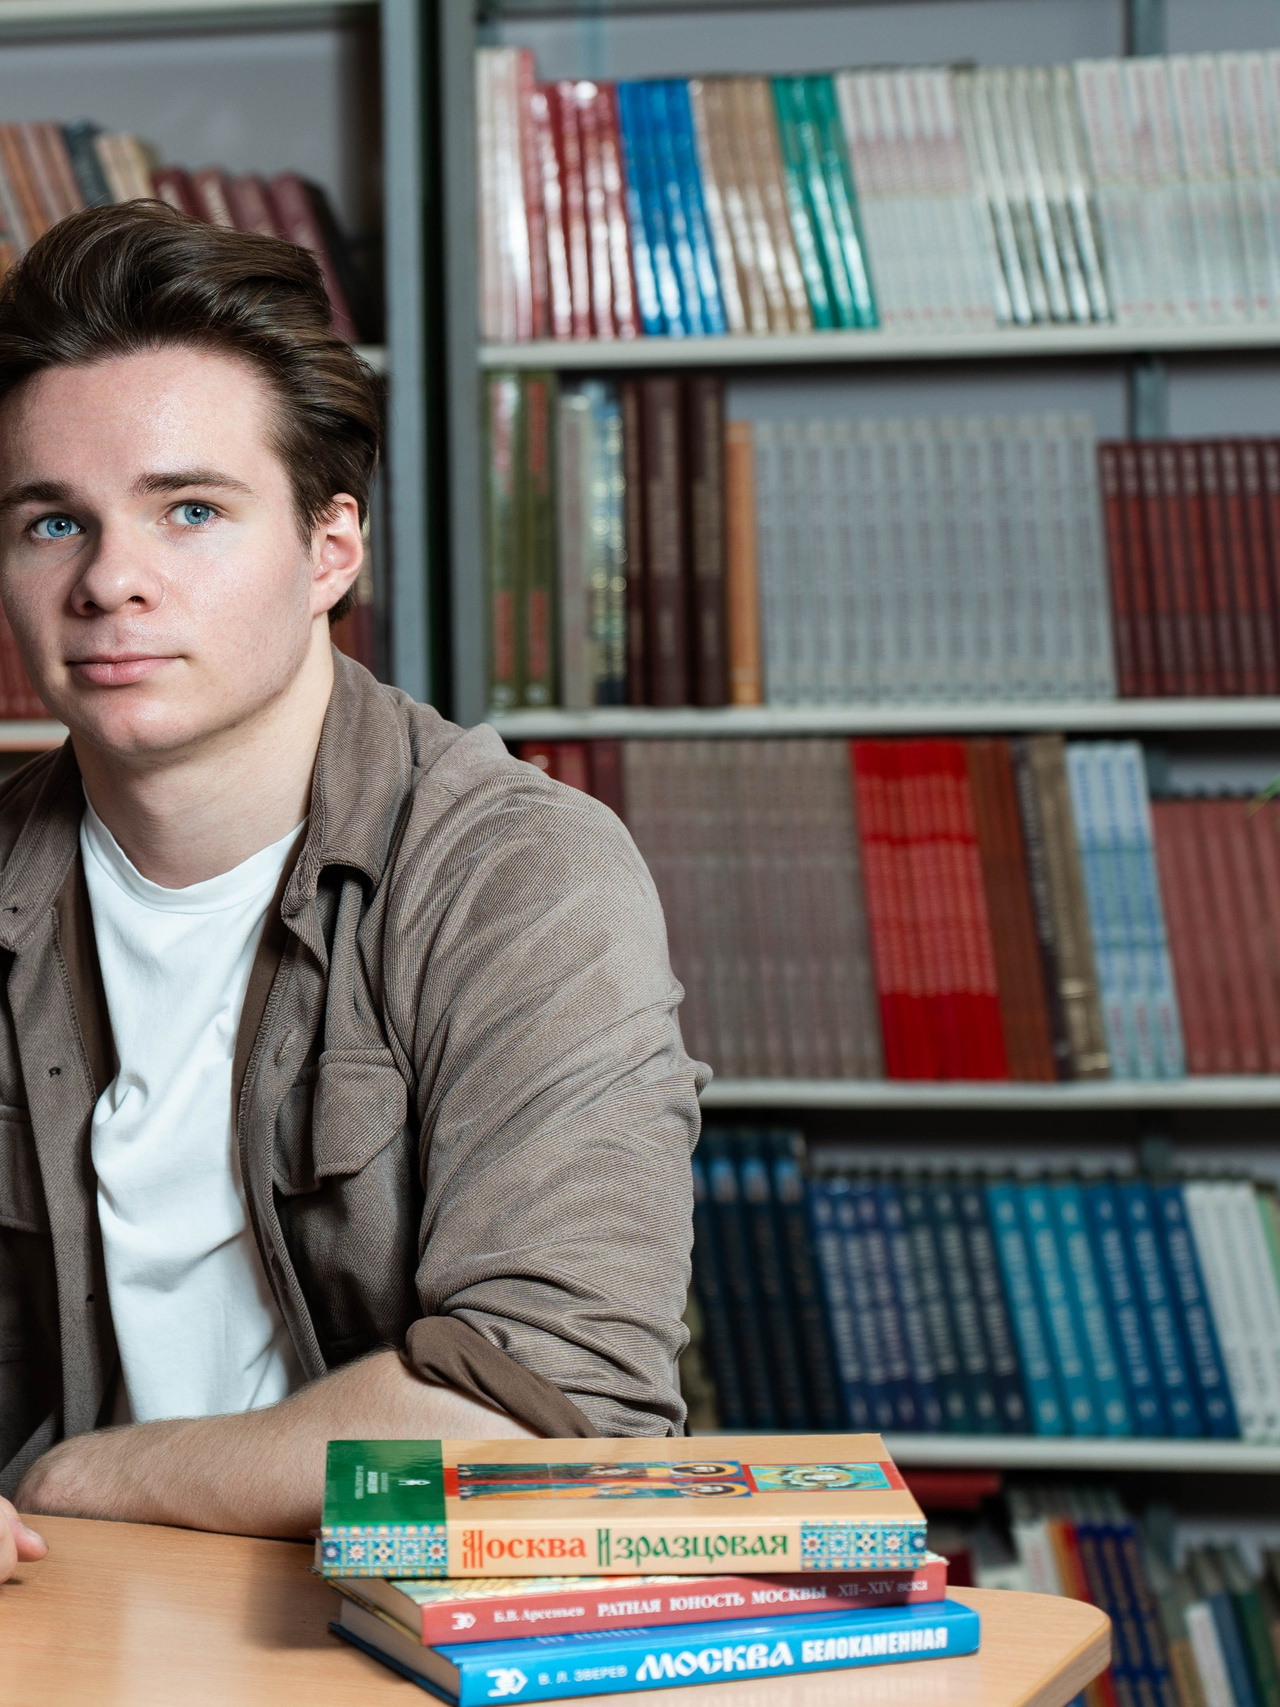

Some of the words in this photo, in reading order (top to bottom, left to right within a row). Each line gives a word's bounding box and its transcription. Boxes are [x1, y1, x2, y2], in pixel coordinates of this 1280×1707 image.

[596, 1528, 789, 1567] Изразцовая
[597, 1599, 662, 1618] РАТНАЯ
[669, 1592, 745, 1611] ЮНОСТЬ
[751, 1586, 827, 1604] МОСКВЫ
[573, 1664, 628, 1682] ЗВЕРЕВ
[635, 1641, 794, 1682] МОСКВА
[801, 1626, 949, 1663] БЕЛОКАМЕННАЯ
